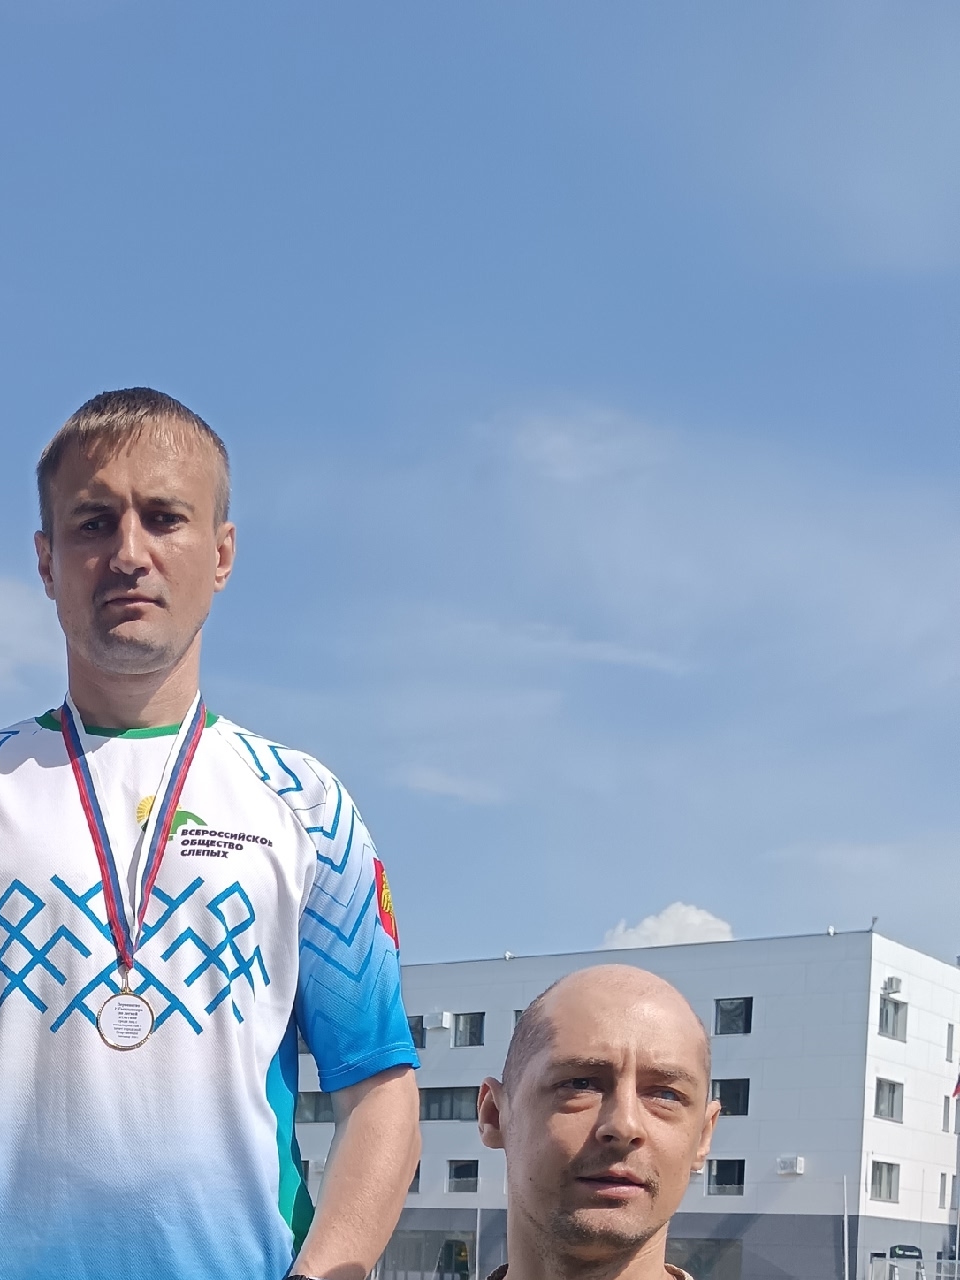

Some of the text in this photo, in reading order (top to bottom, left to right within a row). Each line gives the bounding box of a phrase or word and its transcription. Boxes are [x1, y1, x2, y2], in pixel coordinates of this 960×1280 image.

[181, 828, 273, 848] ВСЕРОССИЙСКОЕ
[181, 838, 244, 851] ОБЩЕСТВО
[180, 849, 229, 858] СЛЕПЫХ
